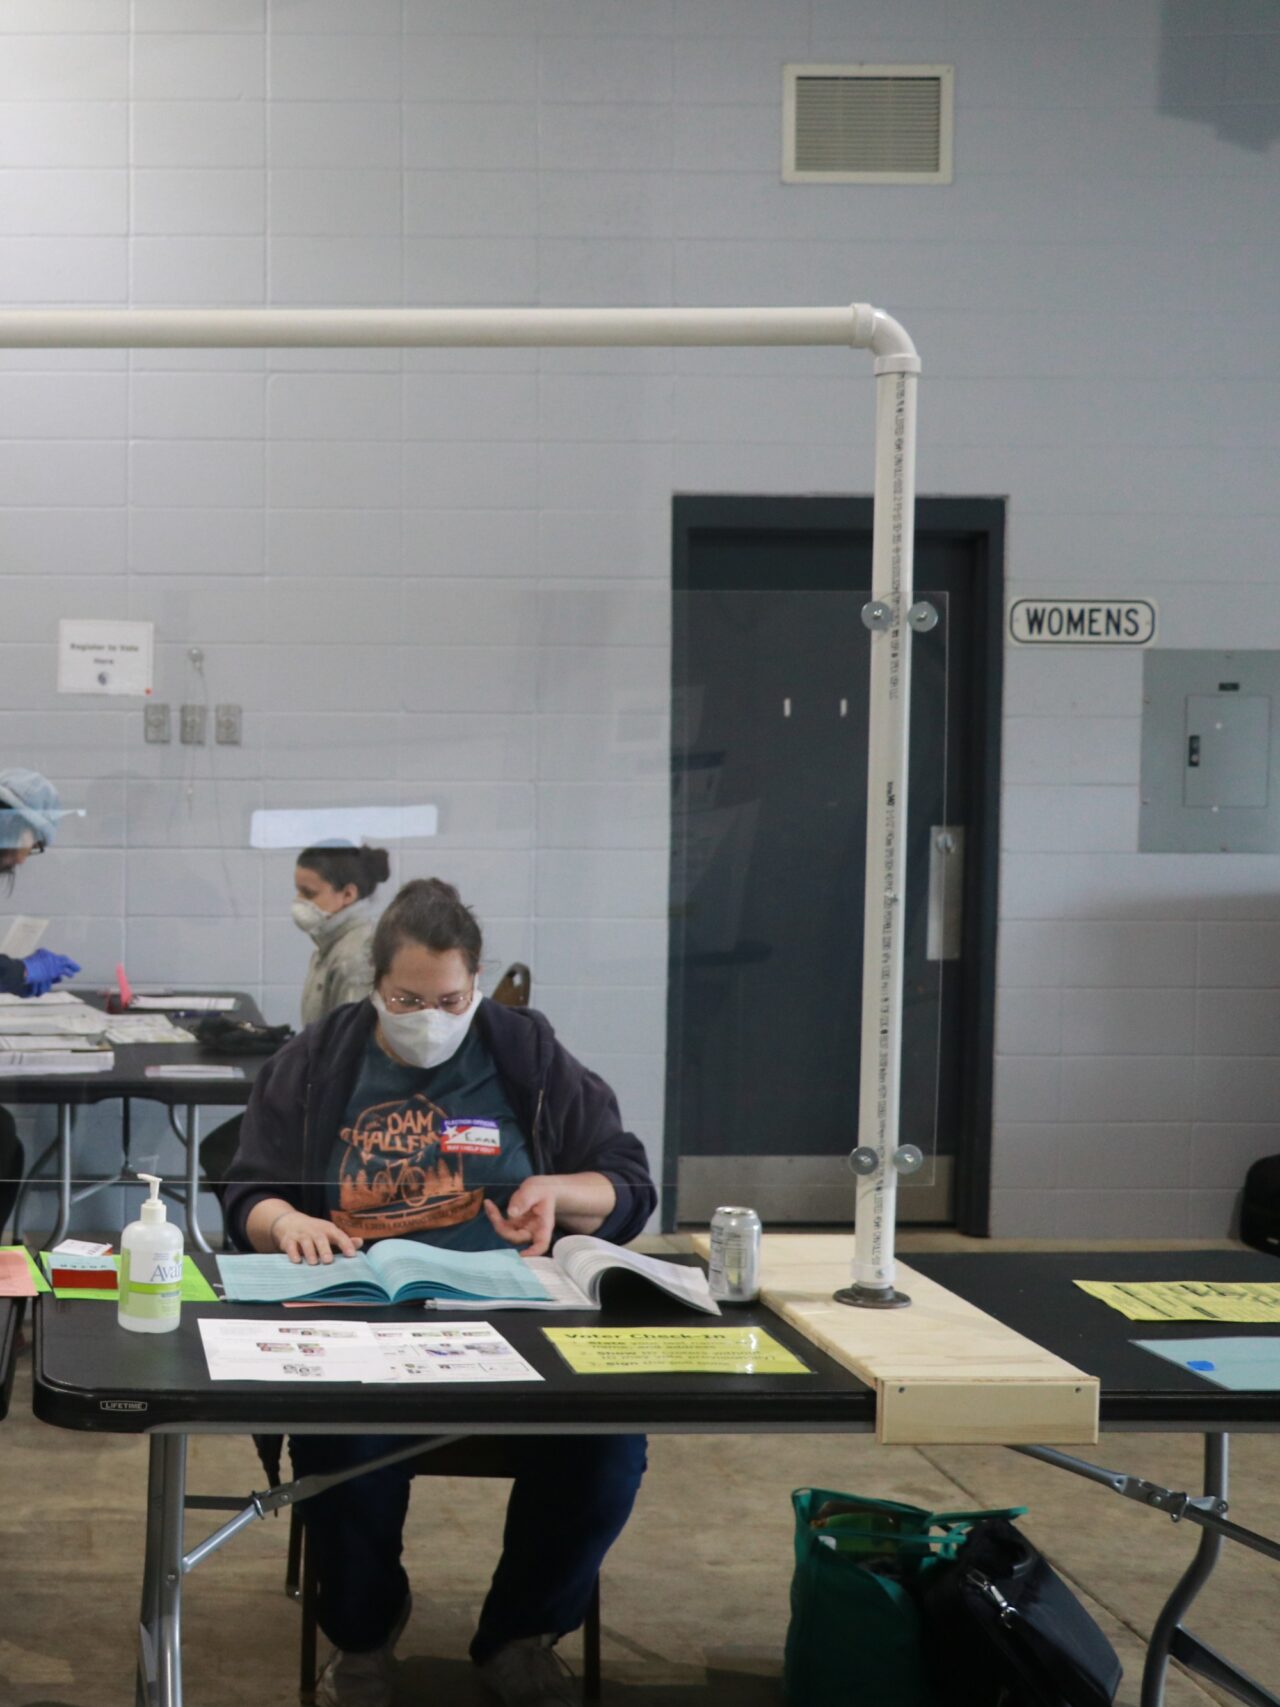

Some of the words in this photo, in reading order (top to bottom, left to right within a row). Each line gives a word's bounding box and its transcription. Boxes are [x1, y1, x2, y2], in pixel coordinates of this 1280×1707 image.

[1026, 607, 1139, 637] WOMENS
[70, 643, 105, 652] Register
[120, 644, 139, 652] Vote
[387, 1109, 434, 1135] DAM
